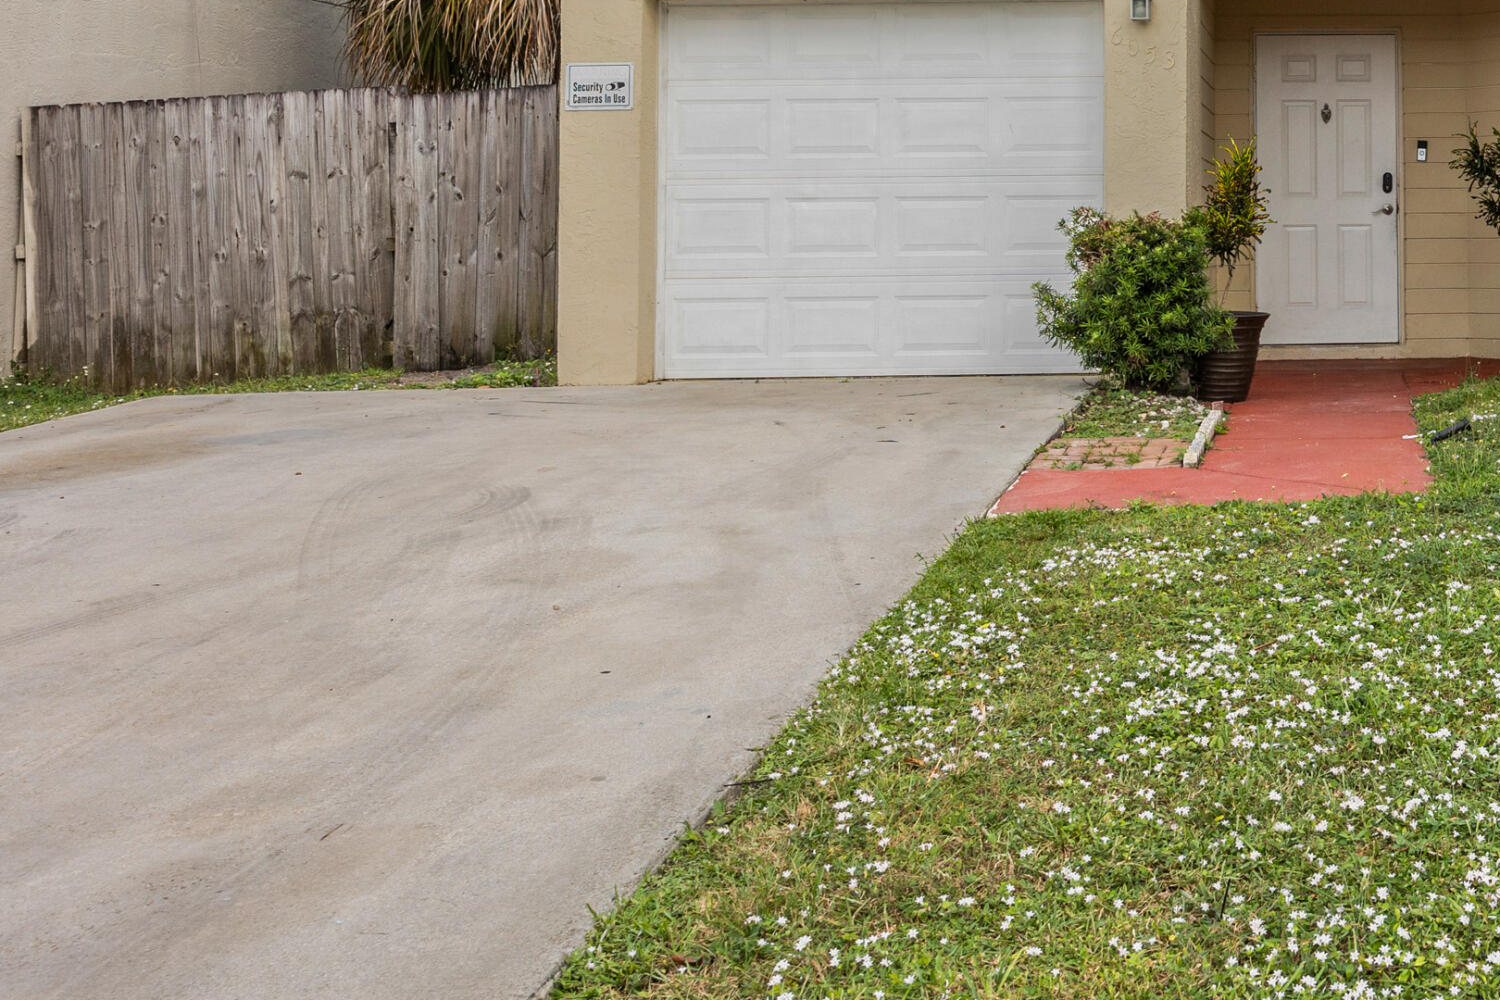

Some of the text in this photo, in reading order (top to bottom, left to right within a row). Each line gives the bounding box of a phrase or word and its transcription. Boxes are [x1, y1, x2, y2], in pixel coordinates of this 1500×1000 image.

[1111, 26, 1176, 71] 6053
[573, 82, 604, 94] Security
[573, 94, 626, 104] Cameras In Use
